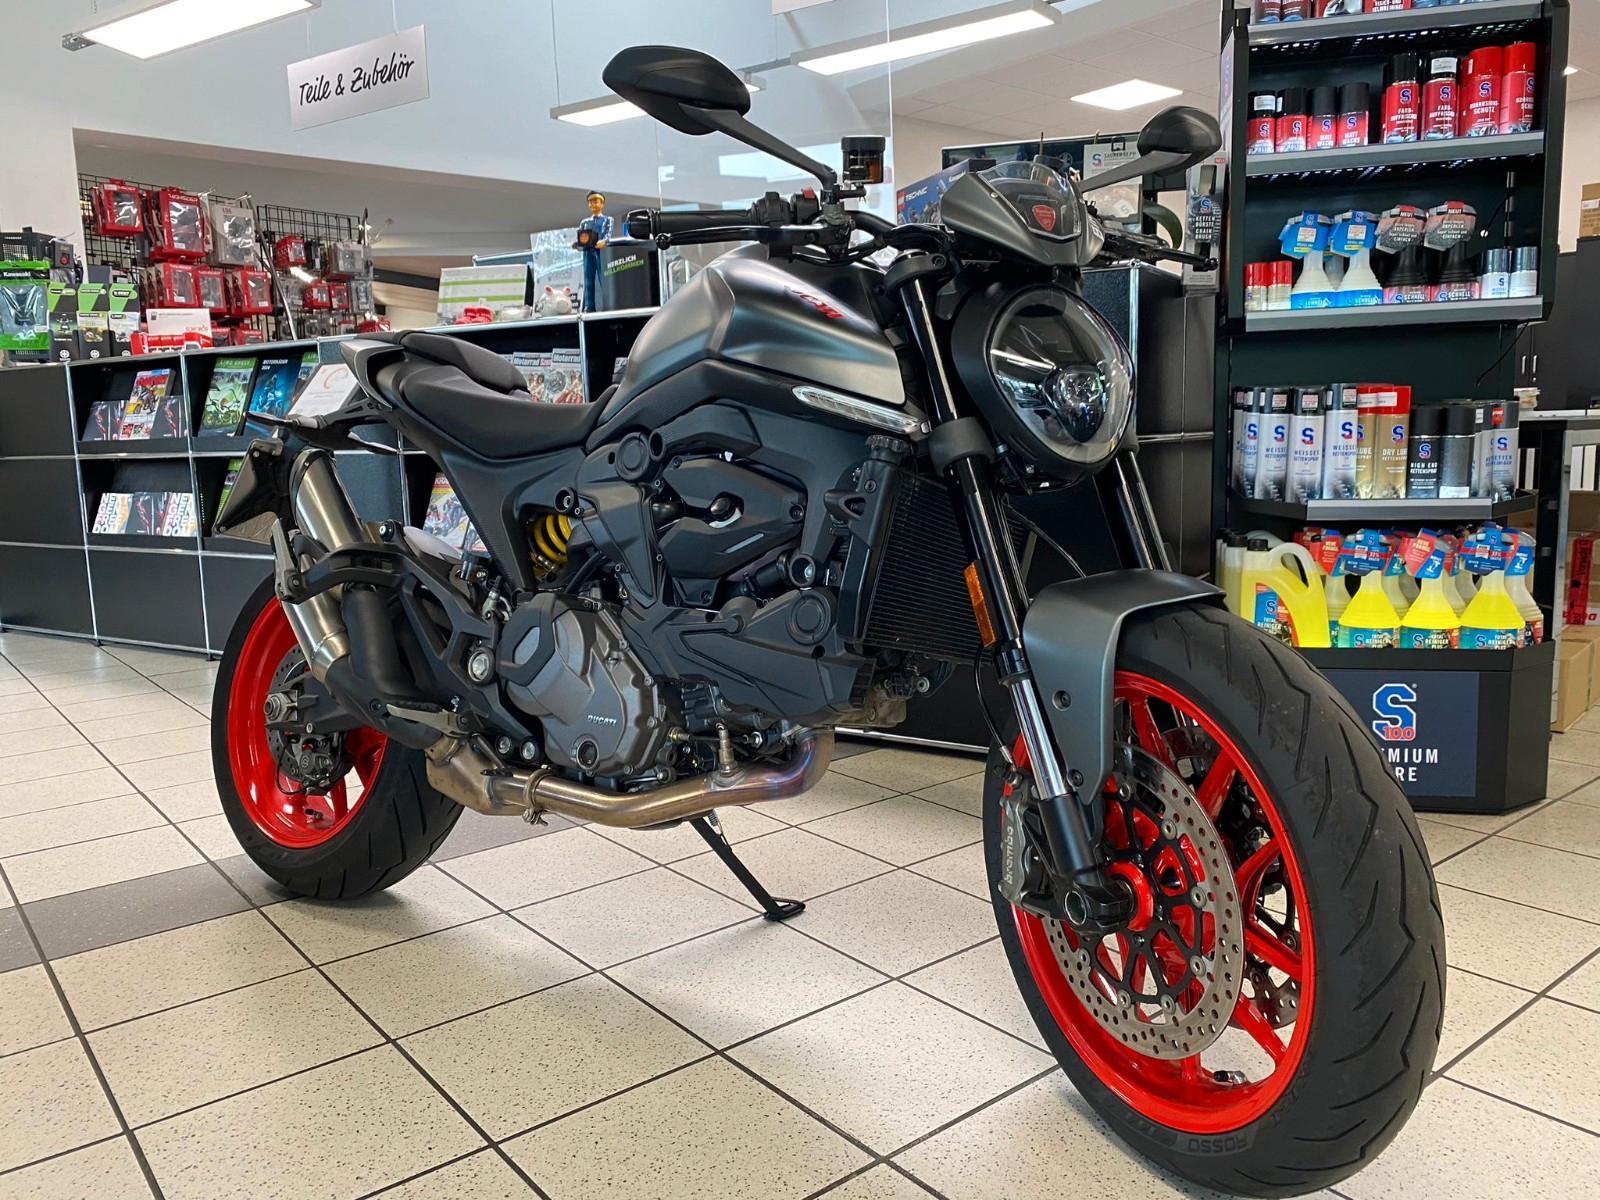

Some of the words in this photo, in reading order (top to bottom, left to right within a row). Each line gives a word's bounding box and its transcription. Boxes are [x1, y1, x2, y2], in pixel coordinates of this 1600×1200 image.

[299, 74, 331, 106] Teile
[335, 73, 345, 96] &
[350, 51, 414, 93] Zubehör
[1473, 107, 1495, 115] SCHUTZ
[905, 186, 928, 202] TECHNIC
[604, 259, 645, 276] WILLKOMMEN
[607, 254, 637, 269] HERZLICH
[513, 357, 540, 366] Motorrad
[1382, 448, 1396, 456] DRY
[587, 714, 617, 727] DUCATI
[1003, 825, 1015, 884] brembo
[1188, 1132, 1248, 1153] ROSSO
